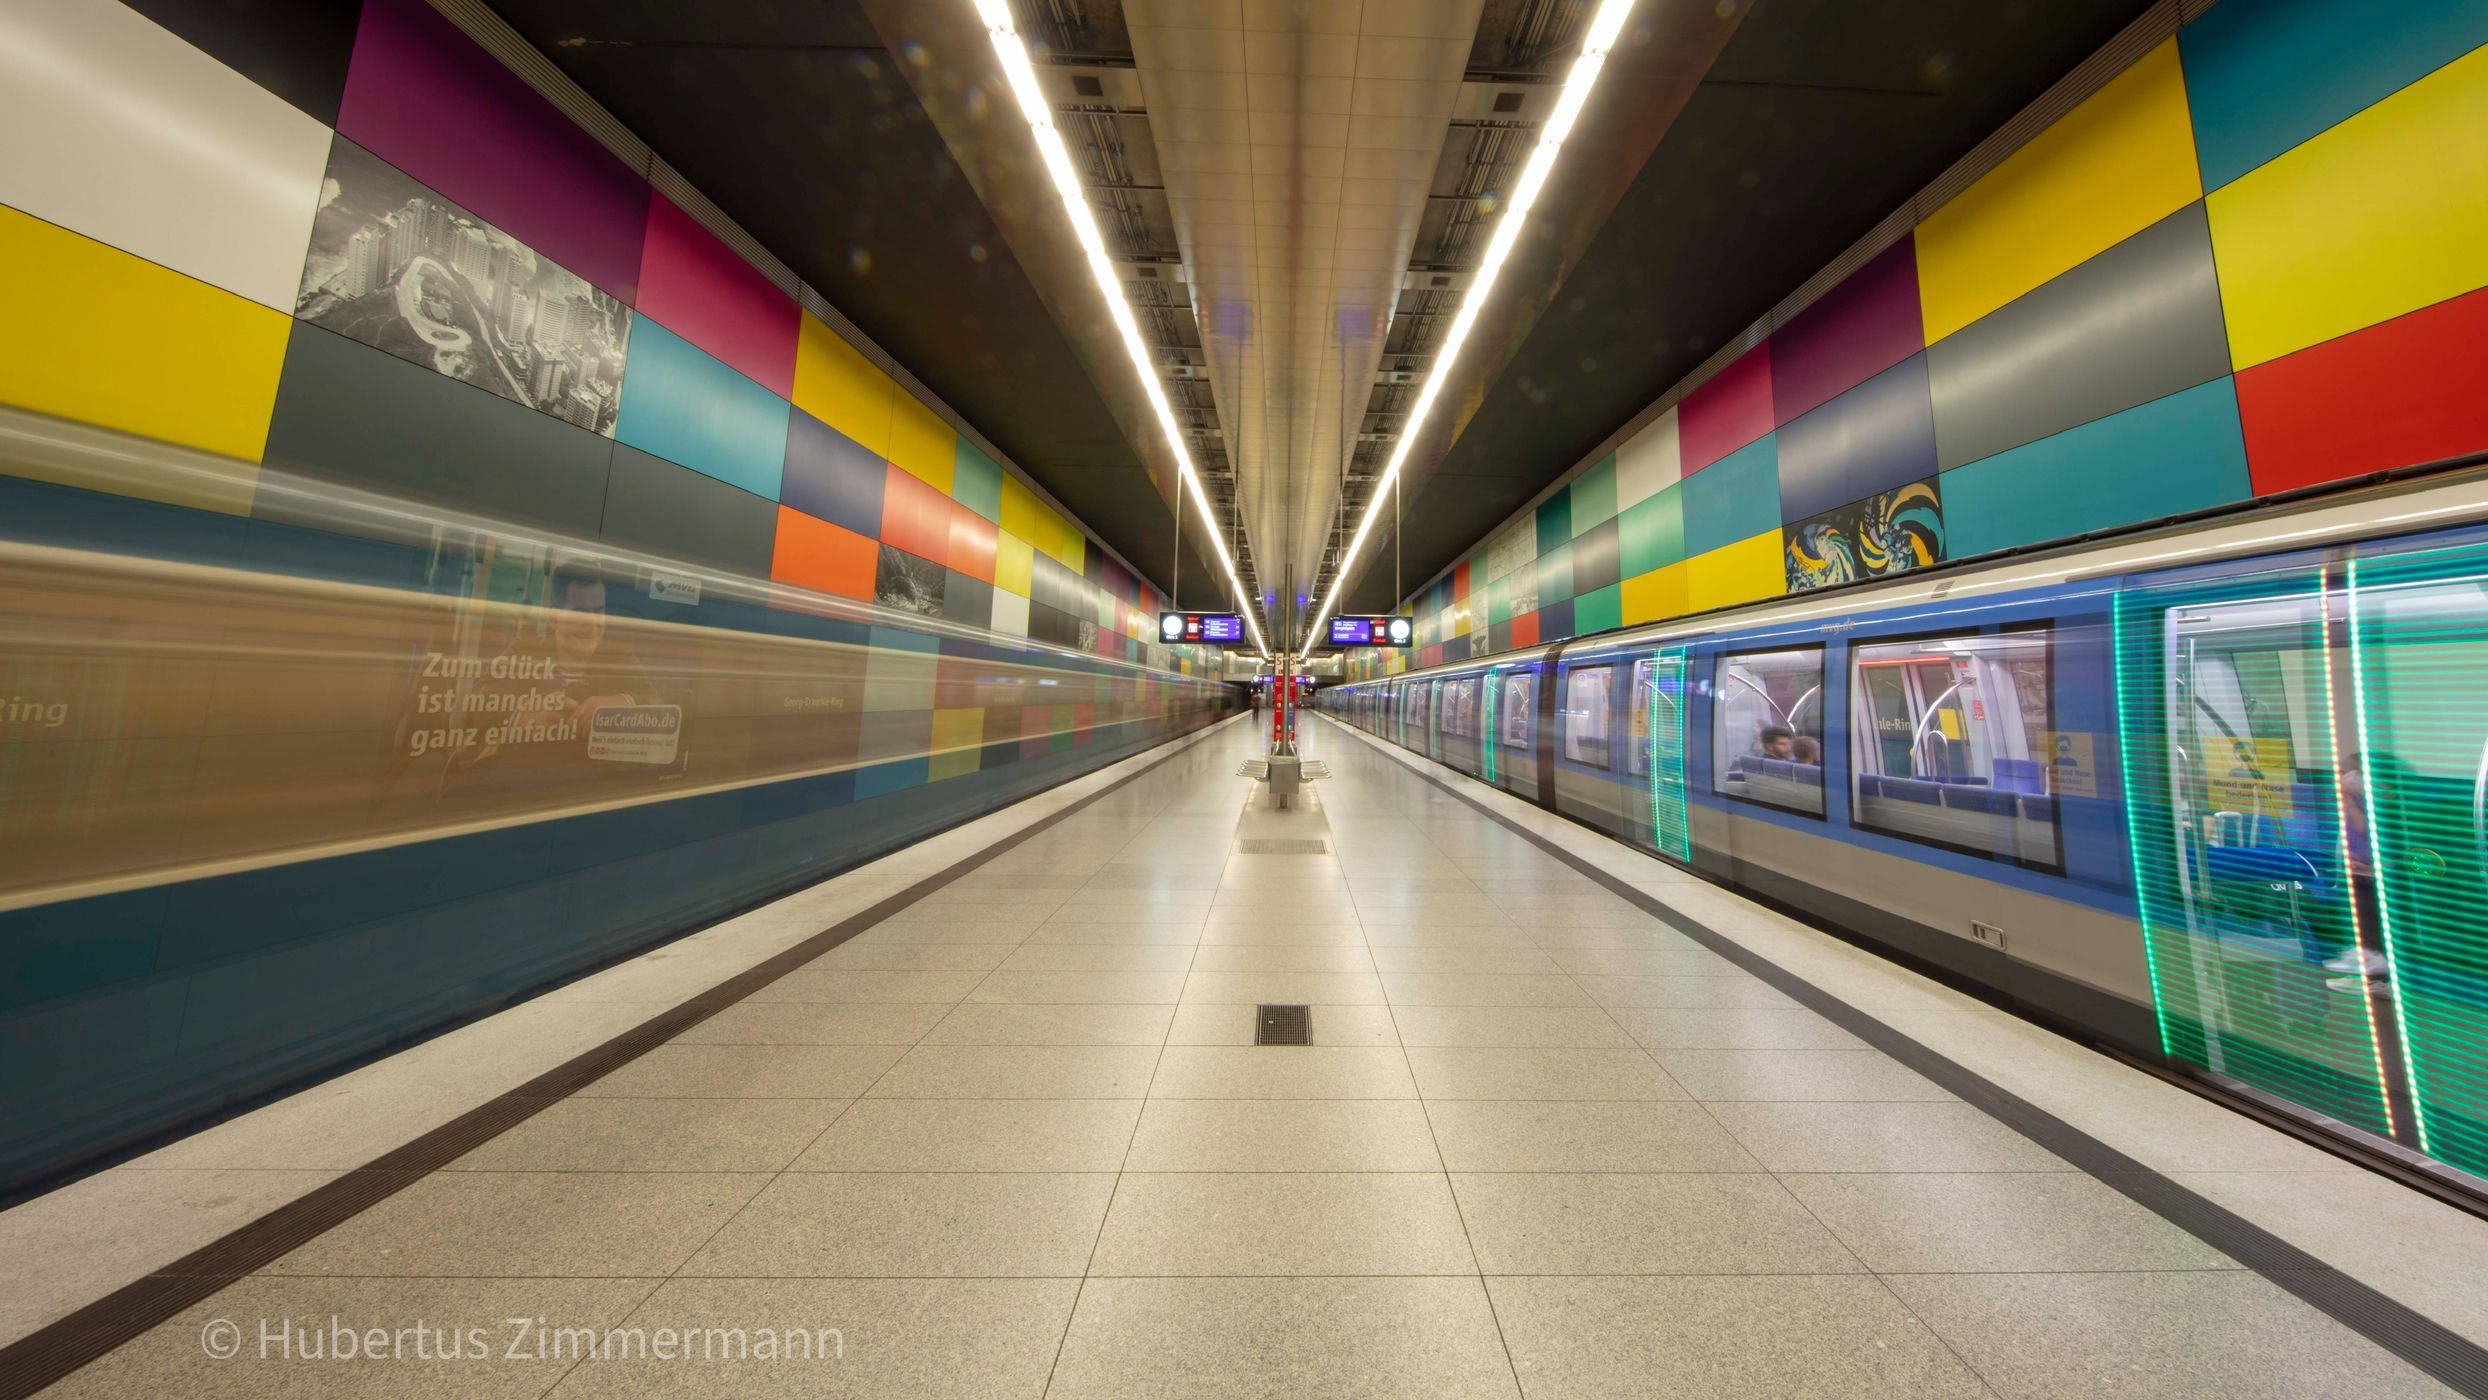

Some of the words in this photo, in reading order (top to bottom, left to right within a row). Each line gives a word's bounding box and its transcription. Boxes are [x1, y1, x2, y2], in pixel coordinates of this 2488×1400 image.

[423, 652, 482, 678] Zum
[490, 655, 557, 680] Glück
[418, 686, 456, 713] ist
[462, 687, 566, 712] manches
[595, 712, 676, 729] IsarCardAbo.de
[409, 728, 479, 756] ganz
[485, 718, 578, 744] einfach!
